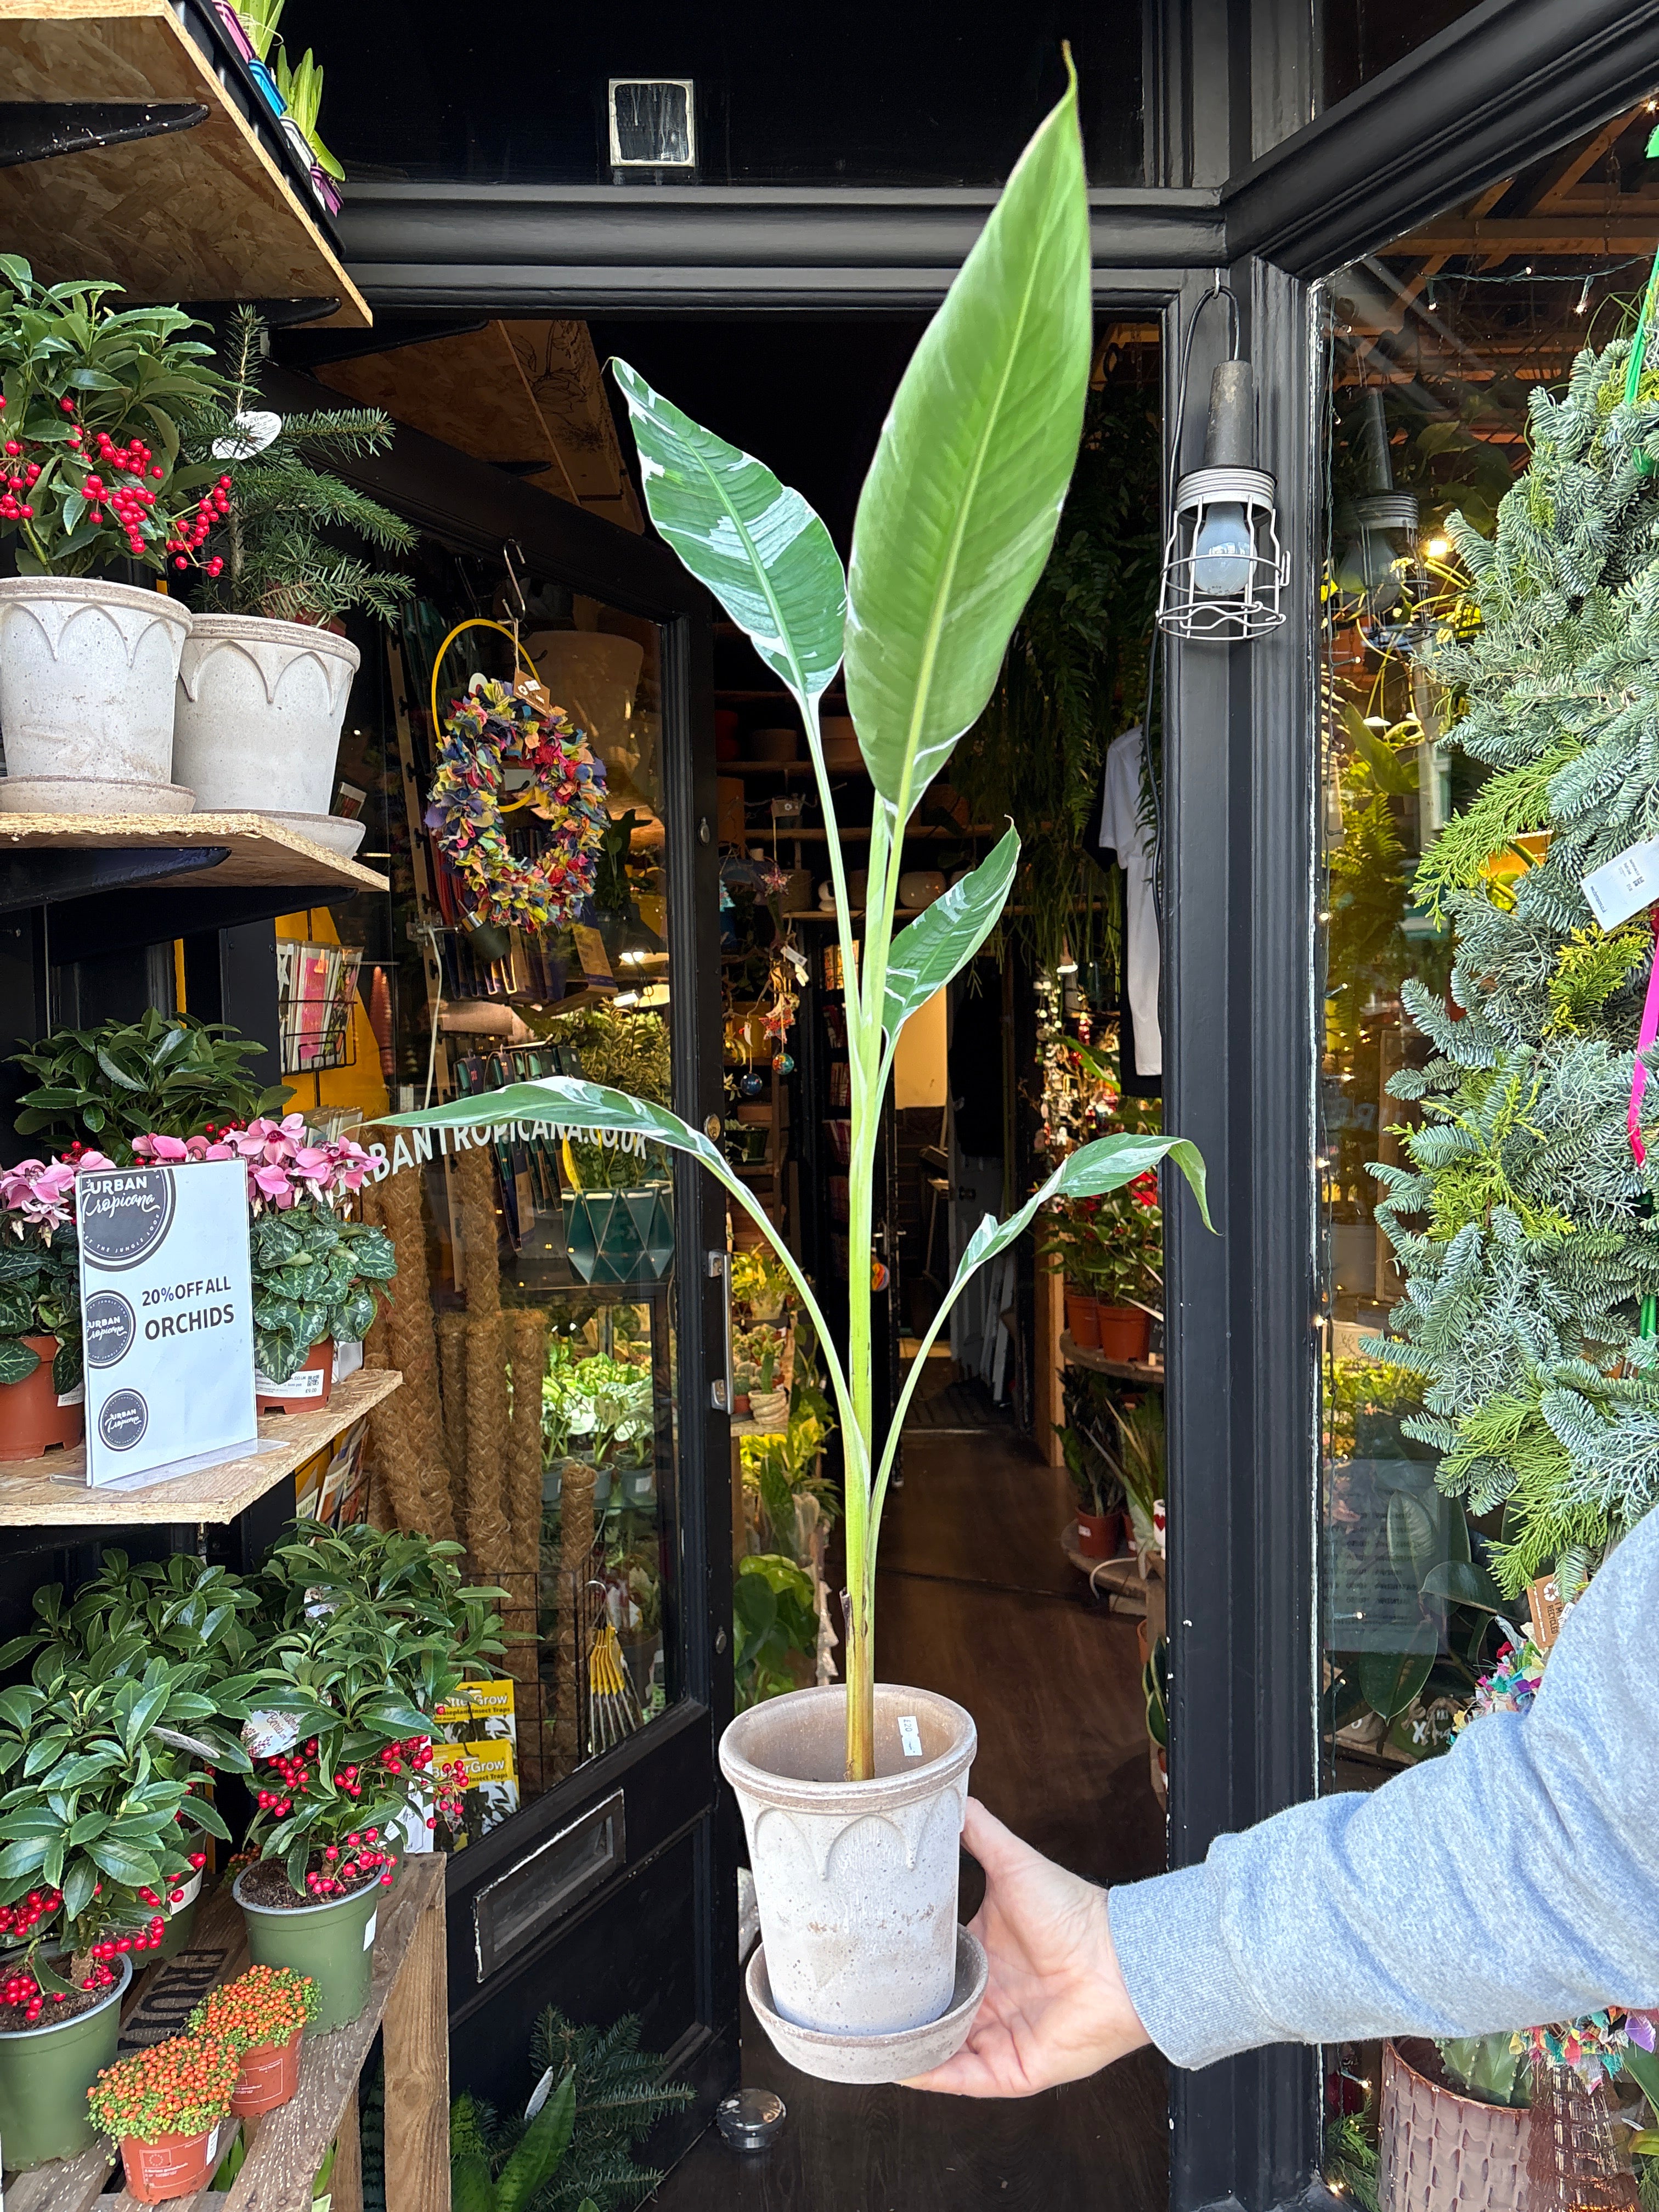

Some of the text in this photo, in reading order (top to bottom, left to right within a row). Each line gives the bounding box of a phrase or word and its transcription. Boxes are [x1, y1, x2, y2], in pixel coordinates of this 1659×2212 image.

[333, 1120, 646, 1200] BANTROPICANA.CO.UK
[89, 1176, 148, 1195] URBAN
[81, 1189, 161, 1223] Tropicana
[89, 1316, 121, 1329] URBAN
[145, 1304, 234, 1340] ORCHIDS
[111, 1408, 137, 1420] URBAN
[1547, 1604, 1559, 1634] RECYCLED
[266, 1711, 285, 1735] Berries
[903, 1719, 913, 1732] £20
[490, 1772, 508, 1780] Traps
